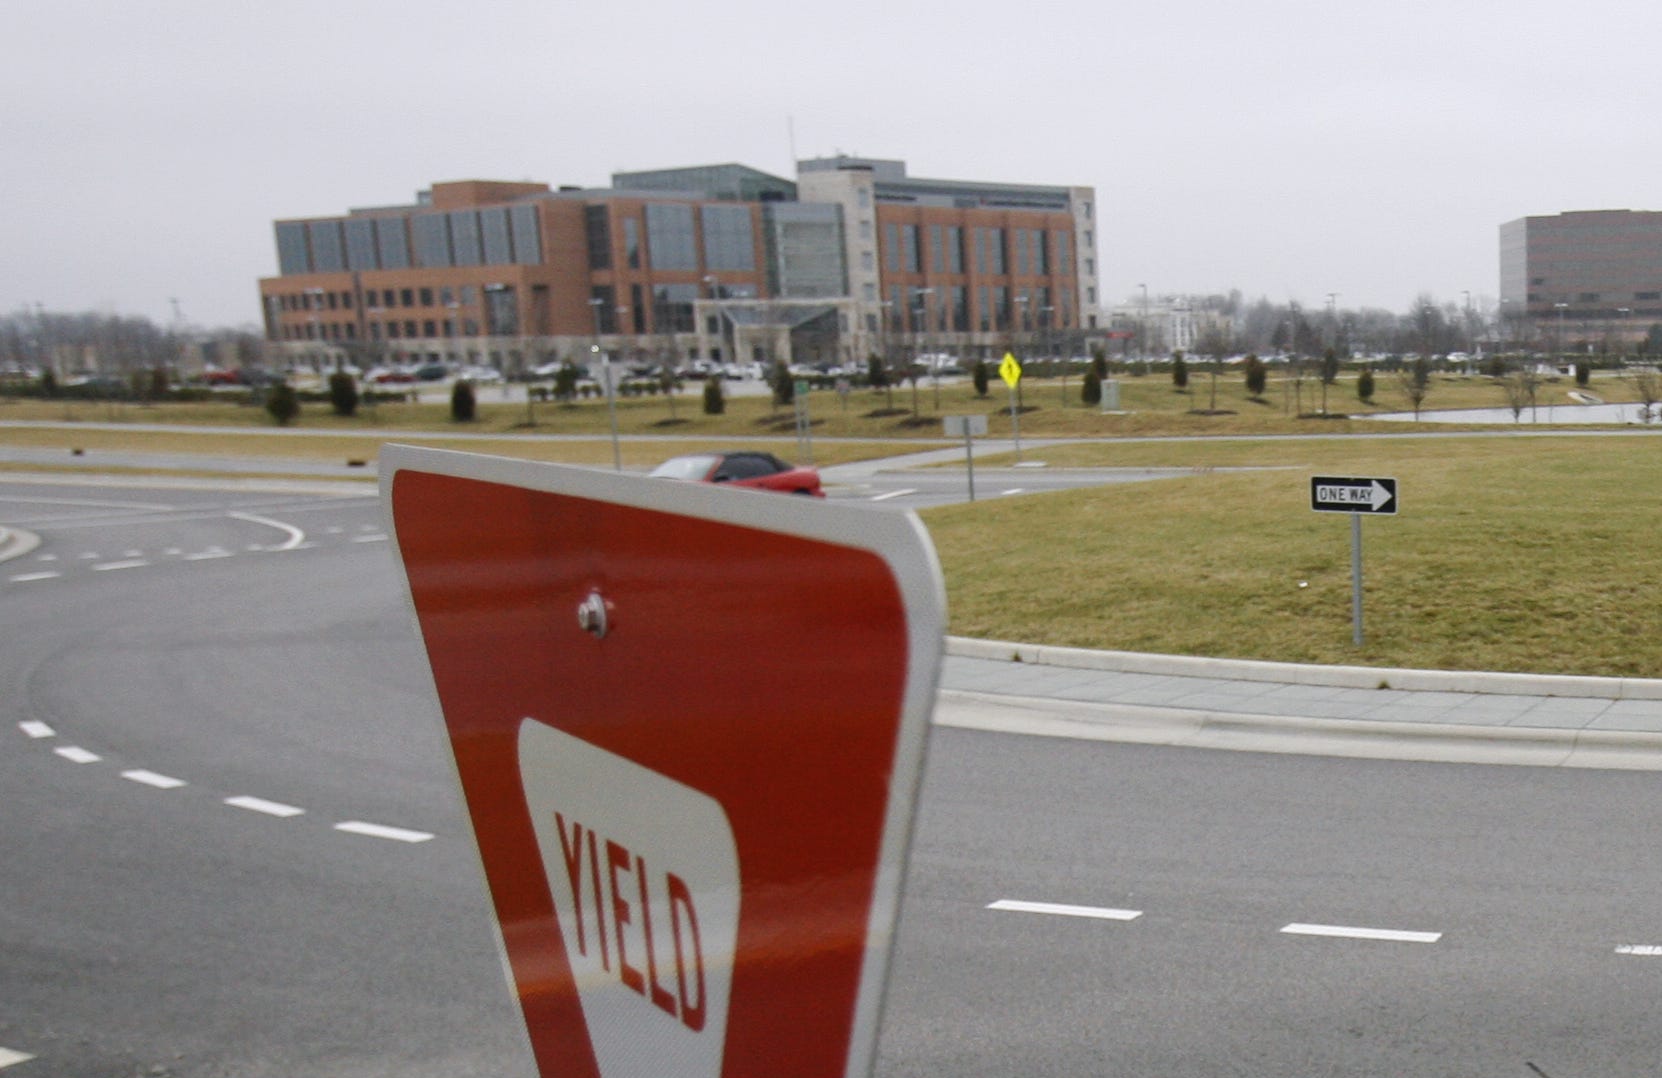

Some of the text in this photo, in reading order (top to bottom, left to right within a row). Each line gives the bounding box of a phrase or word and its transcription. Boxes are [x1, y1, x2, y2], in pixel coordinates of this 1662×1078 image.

[1319, 487, 1373, 503] ONE WAY
[554, 811, 706, 1033] YIELD
